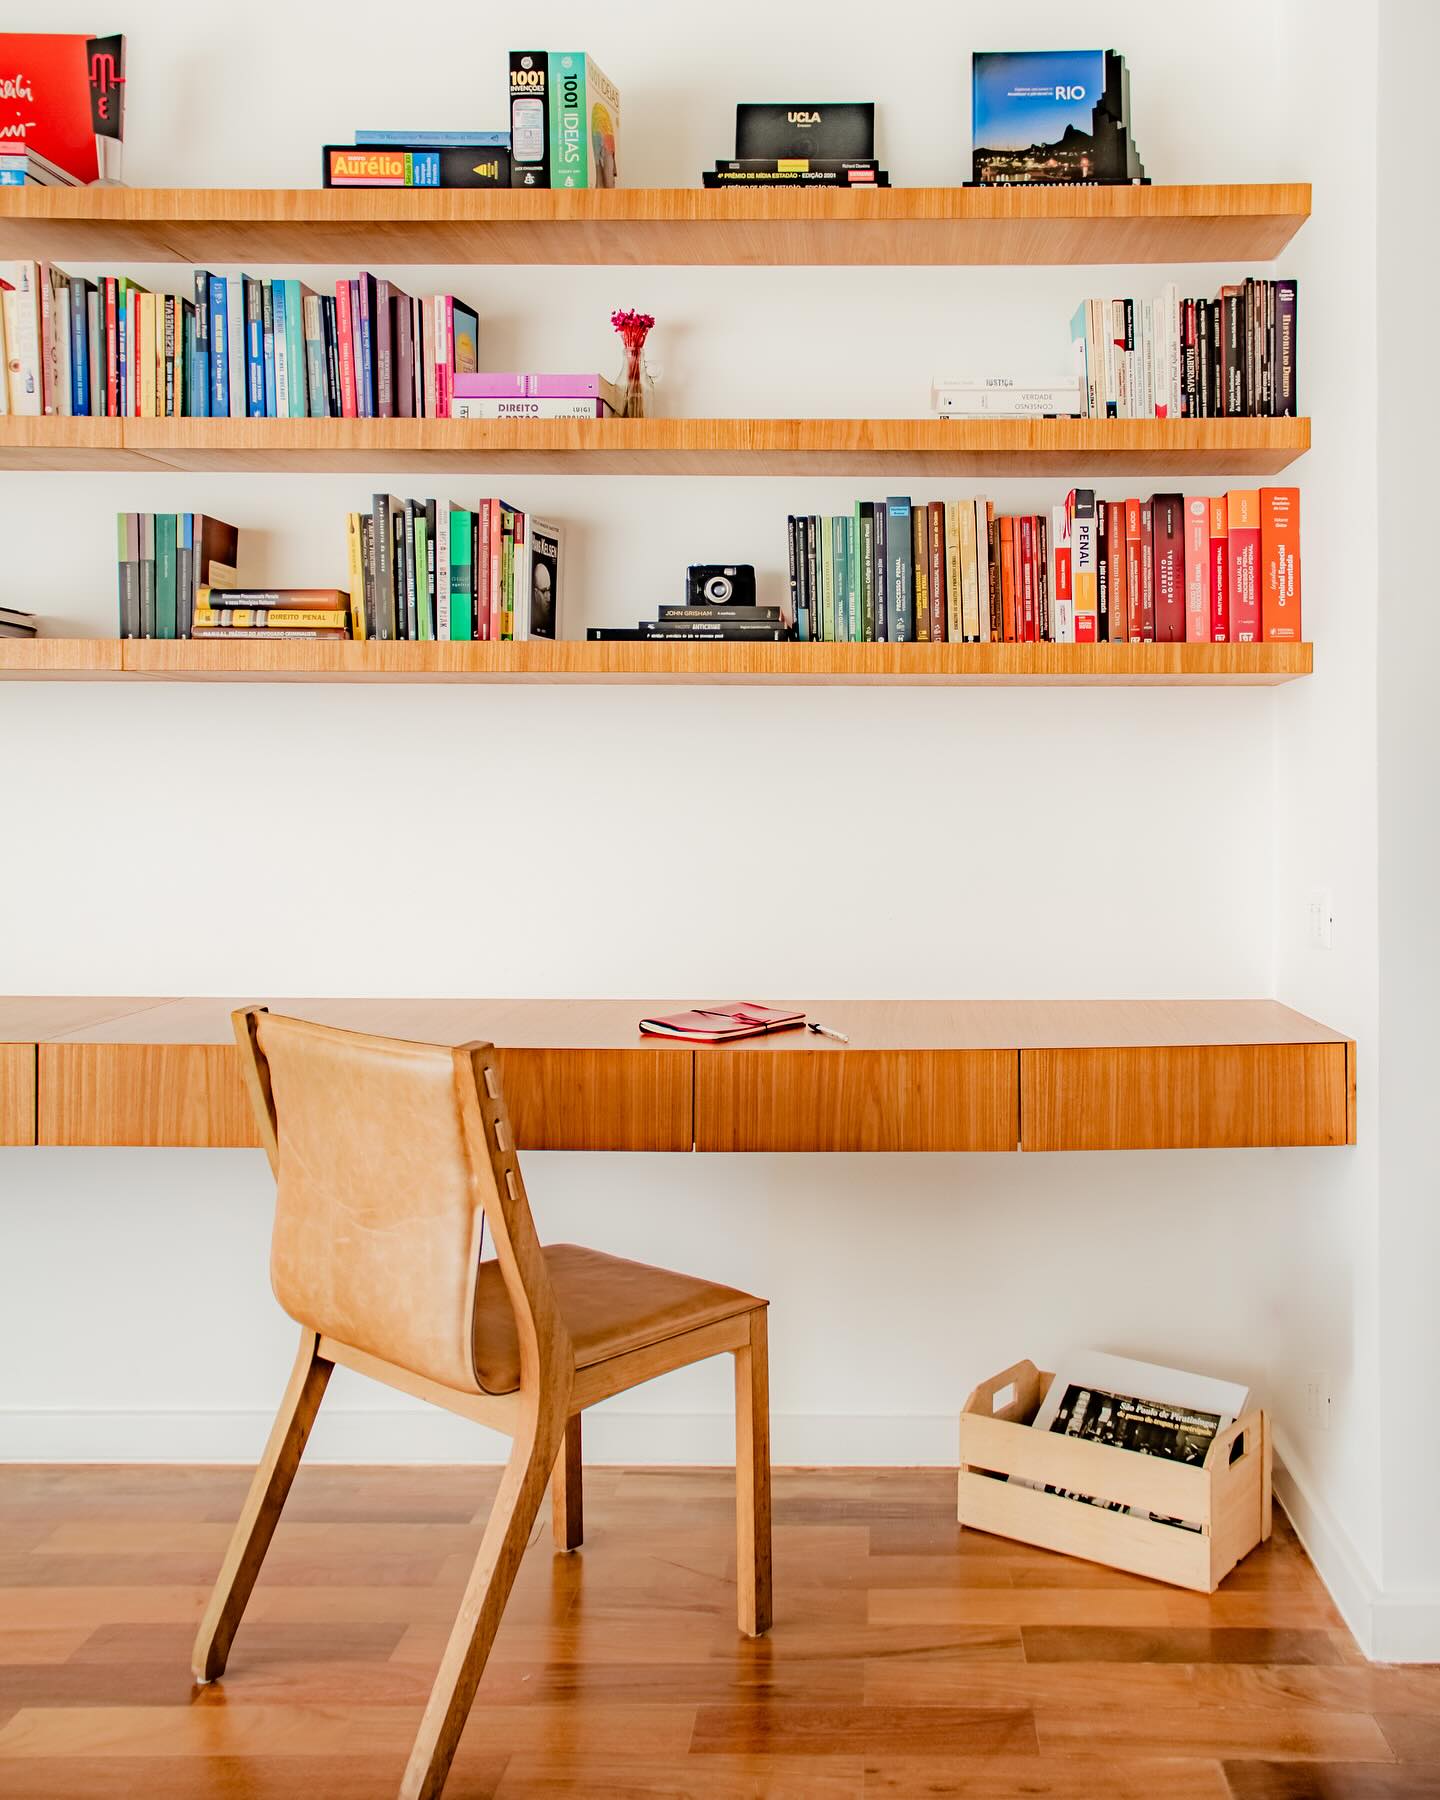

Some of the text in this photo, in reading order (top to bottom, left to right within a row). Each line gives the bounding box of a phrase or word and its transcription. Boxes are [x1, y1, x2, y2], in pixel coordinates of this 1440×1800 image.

[510, 71, 544, 85] 1001
[510, 85, 544, 94] INVENÇÕES
[1055, 86, 1086, 100] RIO
[564, 74, 579, 163] 1001 IDEIAS
[787, 112, 821, 123] UCLA
[334, 154, 402, 176] Aurélio
[1187, 348, 1195, 393] HABERMAS
[1282, 366, 1291, 397] DIREITO
[498, 404, 539, 412] DIREITO
[1080, 526, 1089, 567] PENAL
[1237, 556, 1242, 565] DE
[1278, 544, 1286, 606] Criminal Especial
[1286, 554, 1294, 597] Comentada
[407, 578, 416, 607] MILHÃO
[1120, 1402, 1169, 1419] São Paulo de
